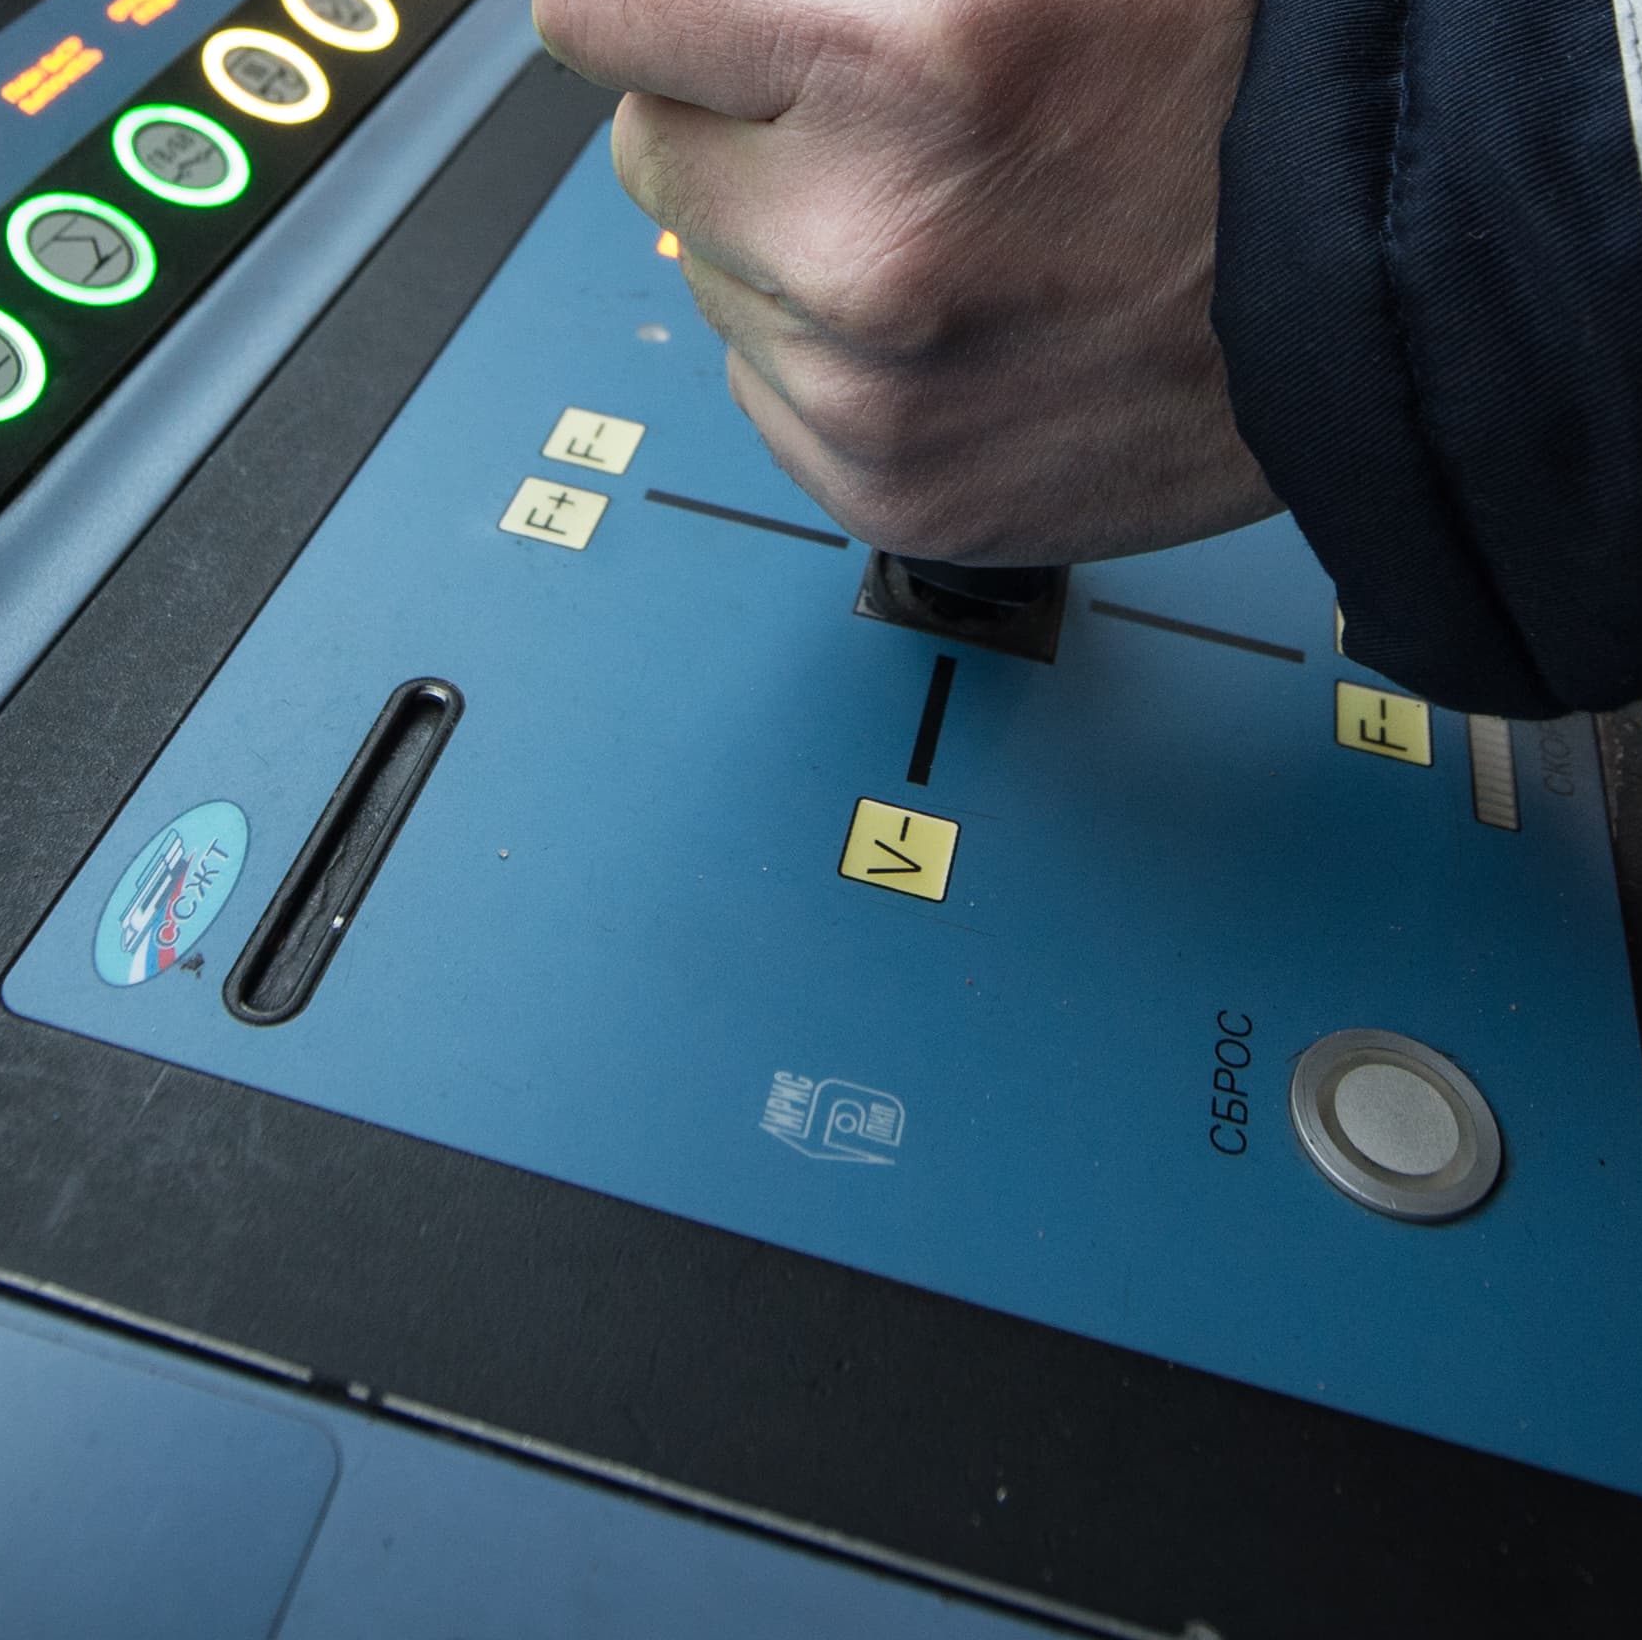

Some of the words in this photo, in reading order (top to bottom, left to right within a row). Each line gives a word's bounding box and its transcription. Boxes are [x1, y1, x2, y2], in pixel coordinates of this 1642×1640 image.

[525, 491, 576, 536] F+
[1360, 698, 1409, 752] F-
[866, 815, 923, 875] V-
[1209, 1008, 1254, 1157] СБРОС
